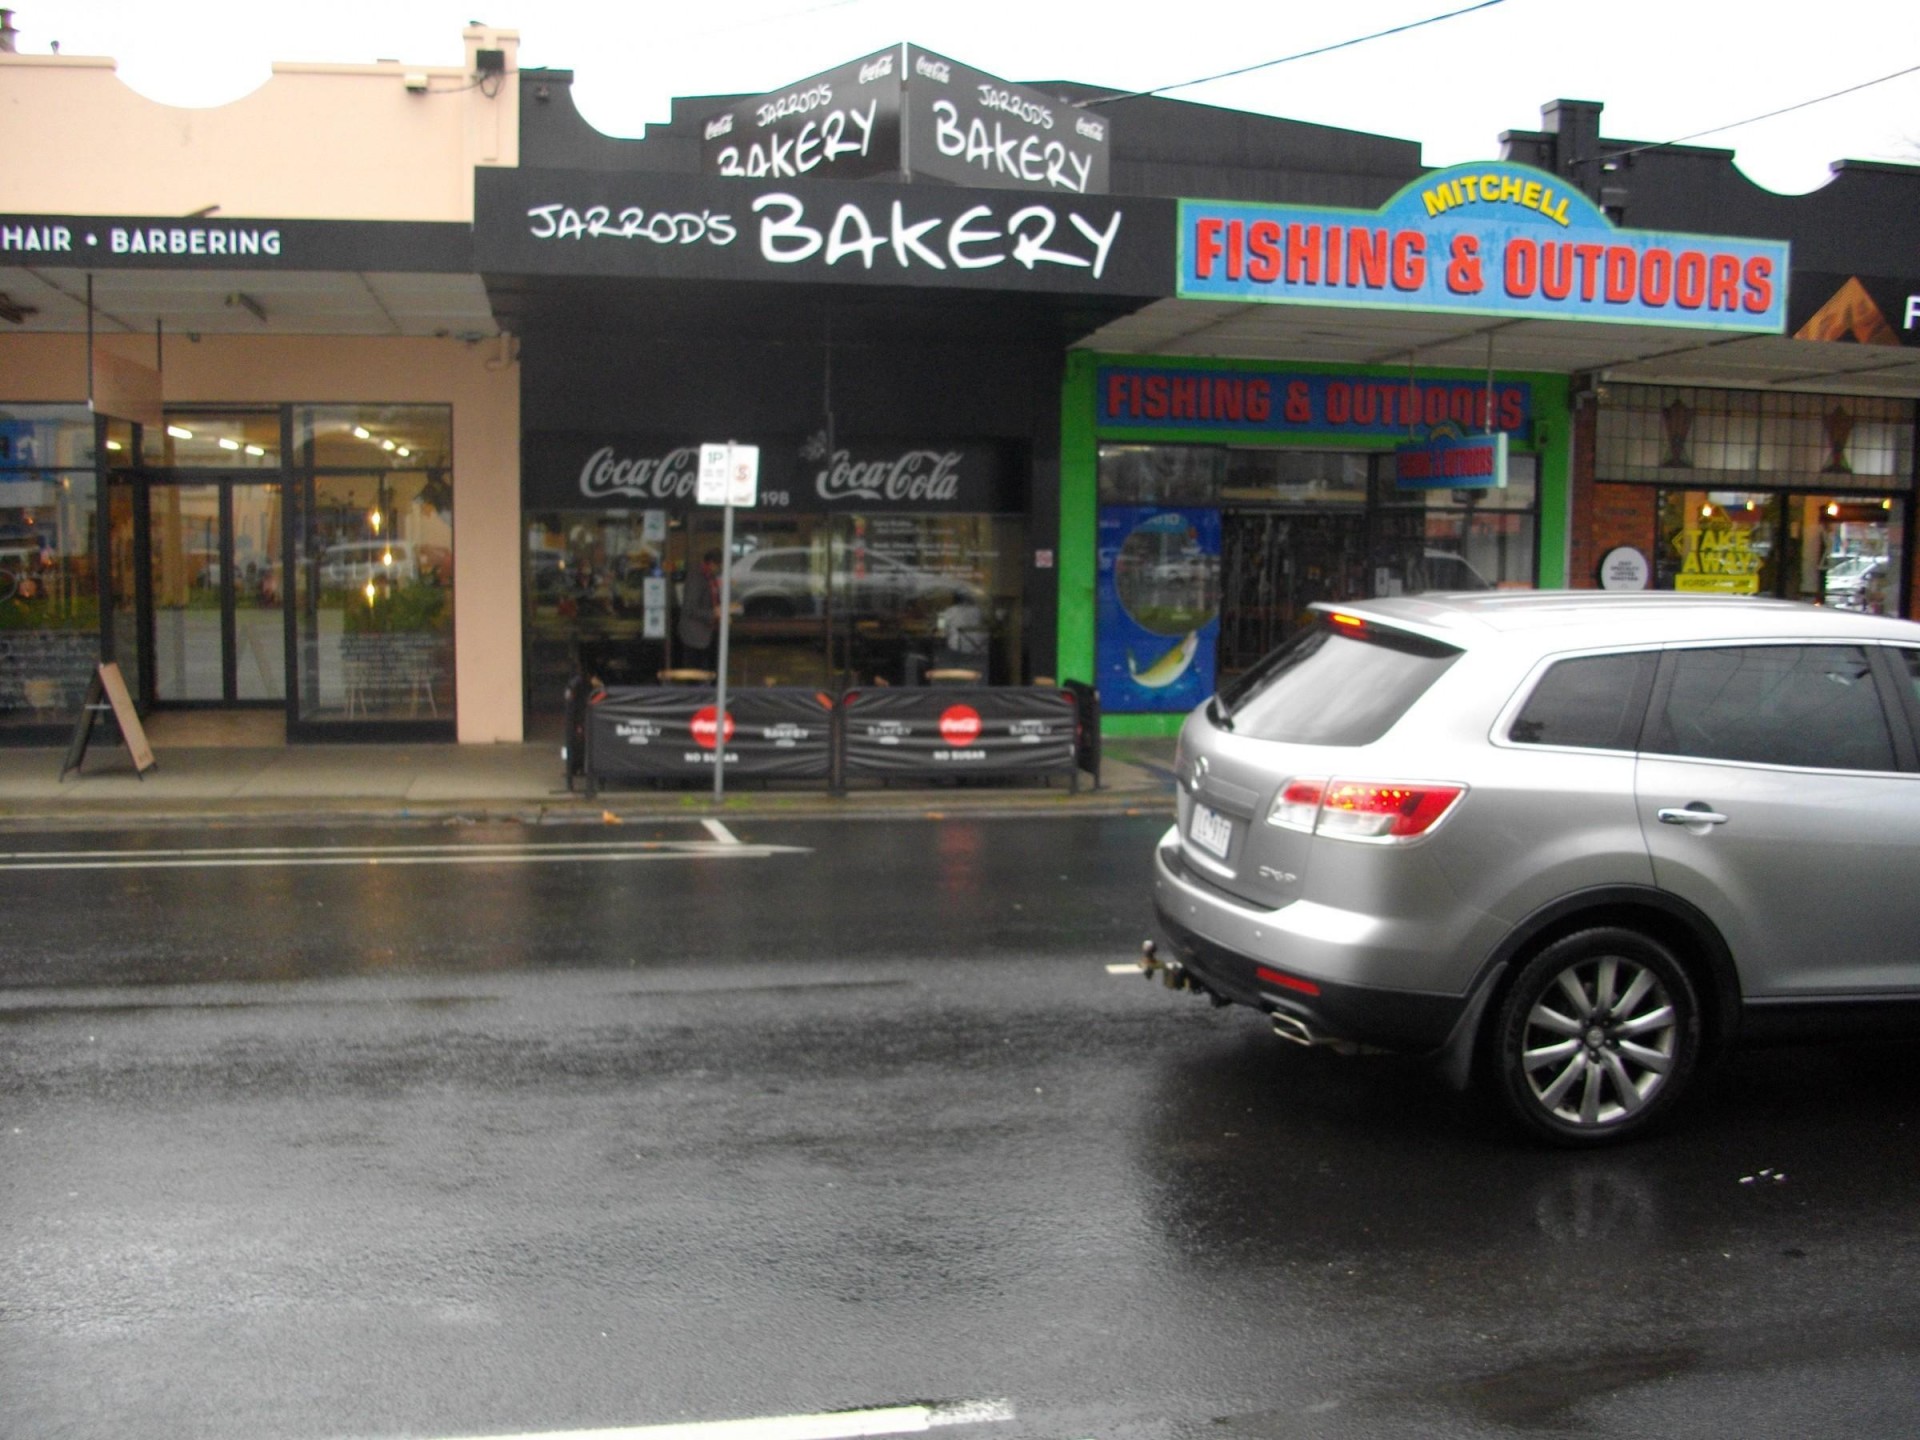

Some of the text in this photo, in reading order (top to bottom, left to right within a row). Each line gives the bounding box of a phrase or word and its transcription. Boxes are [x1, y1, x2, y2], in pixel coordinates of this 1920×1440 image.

[757, 83, 833, 127] JARROD'S
[977, 84, 1053, 130] JARROD'S
[932, 99, 1092, 193] BAKERY
[1422, 174, 1570, 228] MITCHELL
[1, 225, 281, 255] HAIR BARBERING
[528, 193, 1123, 279] JARROD'S BAKERY
[1195, 217, 1774, 314] FISHING & OUTDOORS
[1107, 373, 1523, 430] FISHING & OUTDOORS
[816, 450, 964, 500] Coca-Cola
[761, 491, 790, 506] 198
[1688, 530, 1751, 551] TAKE
[684, 753, 739, 763] NO SUAR
[933, 750, 986, 760] NO SUGAR
